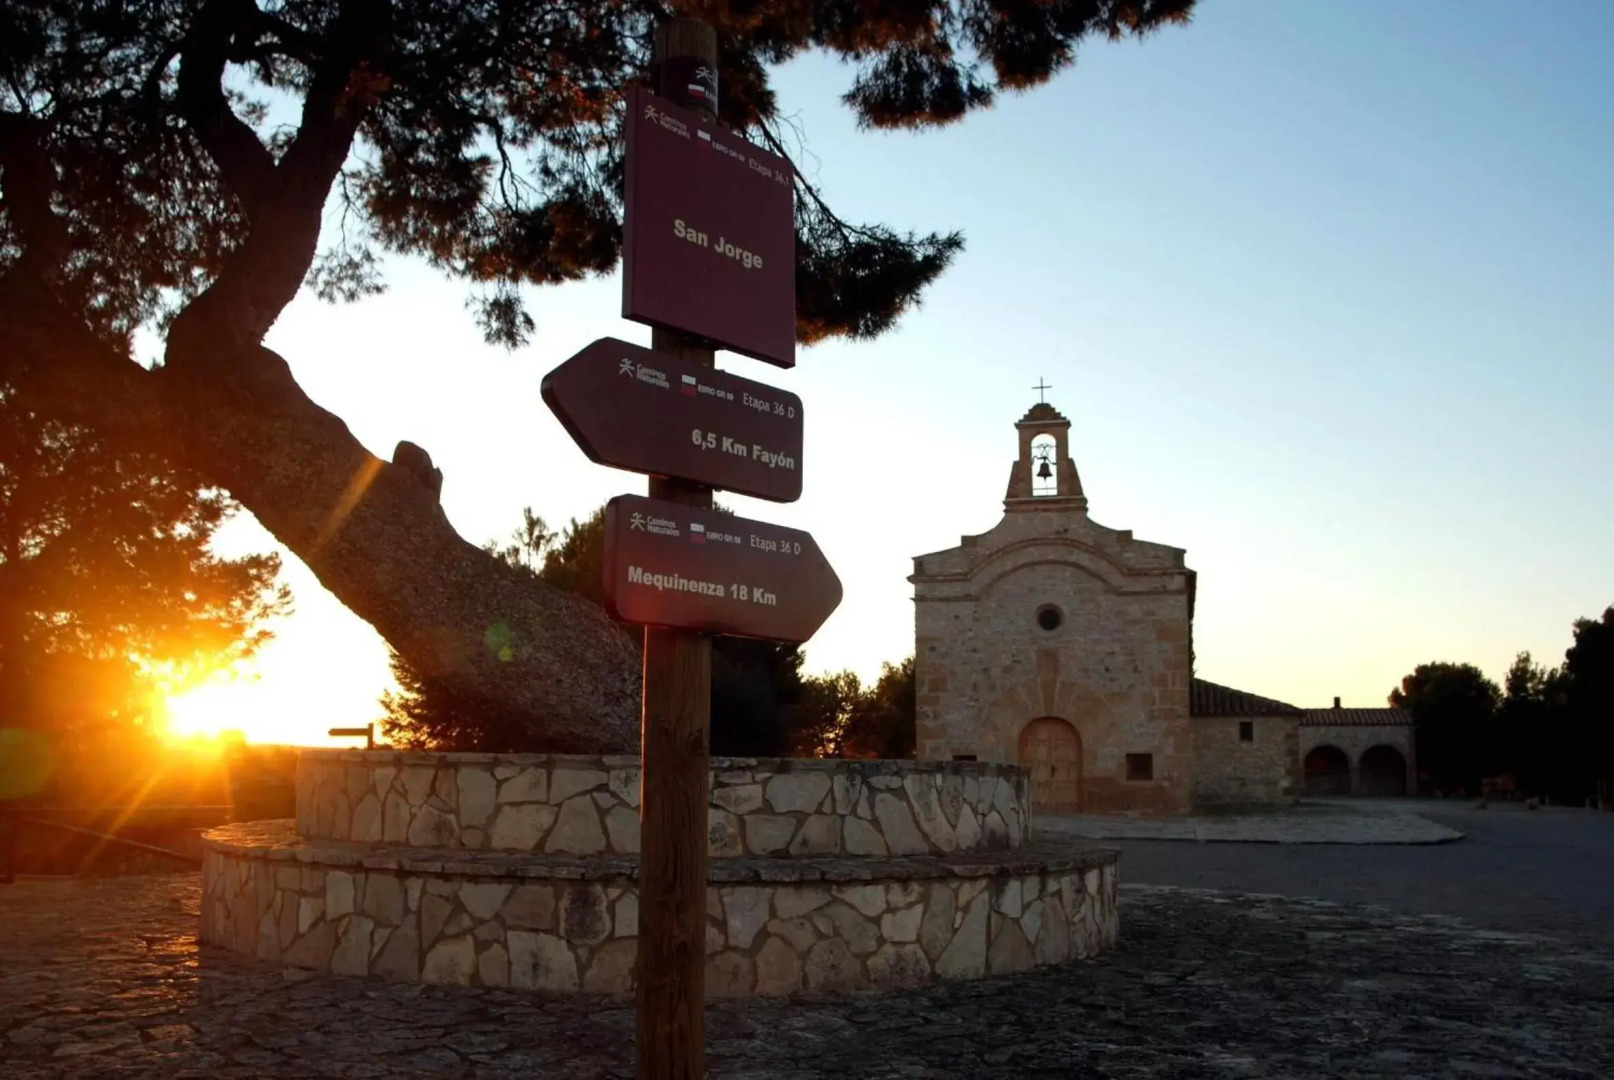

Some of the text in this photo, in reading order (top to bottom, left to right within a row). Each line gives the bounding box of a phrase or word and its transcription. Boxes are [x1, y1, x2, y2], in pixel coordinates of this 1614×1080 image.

[749, 158, 772, 178] Etapa
[674, 219, 763, 269] San Jorge
[743, 393, 795, 419] Etapa 36 D
[692, 429, 795, 470] 6,5 Km Fayón
[646, 515, 676, 529] Caminos
[750, 534, 801, 555] Etapa 36 D
[628, 565, 777, 606] Mequinenza 18 Km
